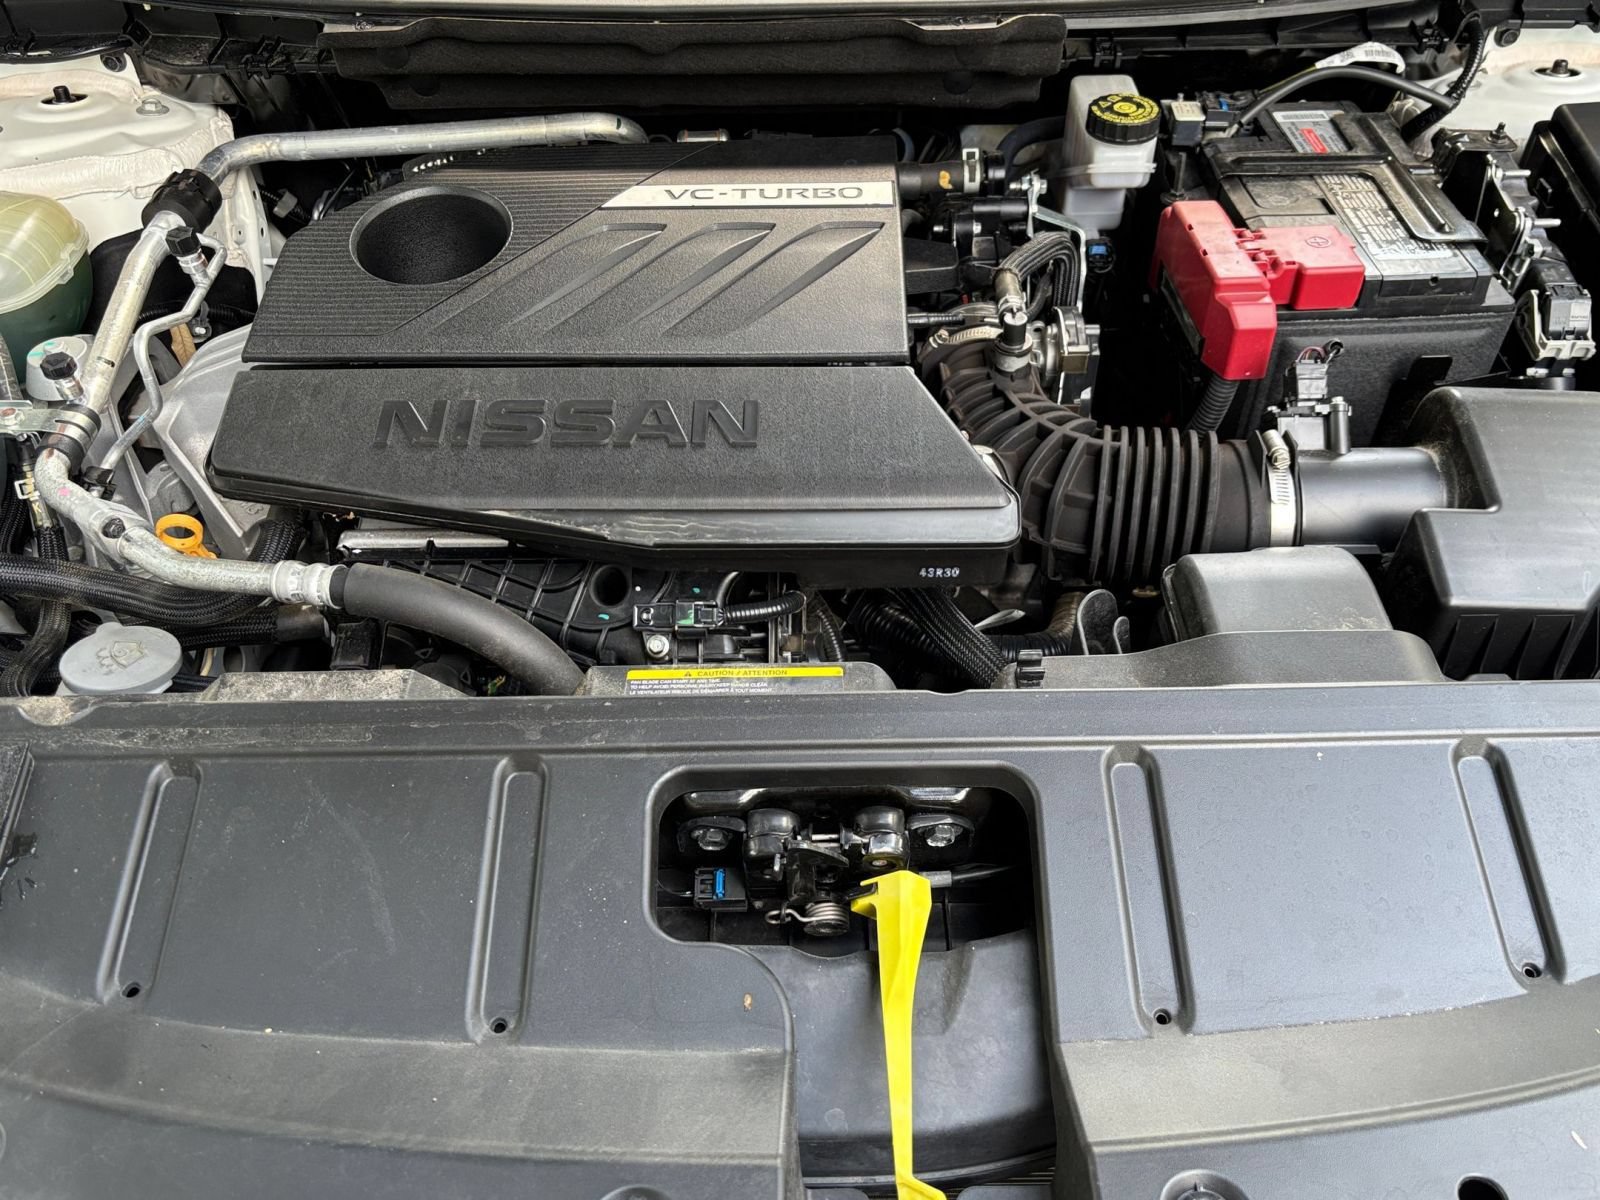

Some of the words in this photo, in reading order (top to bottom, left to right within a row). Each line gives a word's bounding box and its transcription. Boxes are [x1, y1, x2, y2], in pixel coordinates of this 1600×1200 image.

[664, 187, 863, 200] VC-TURBO
[373, 399, 759, 448] NISSAN
[919, 567, 960, 578] 43R30
